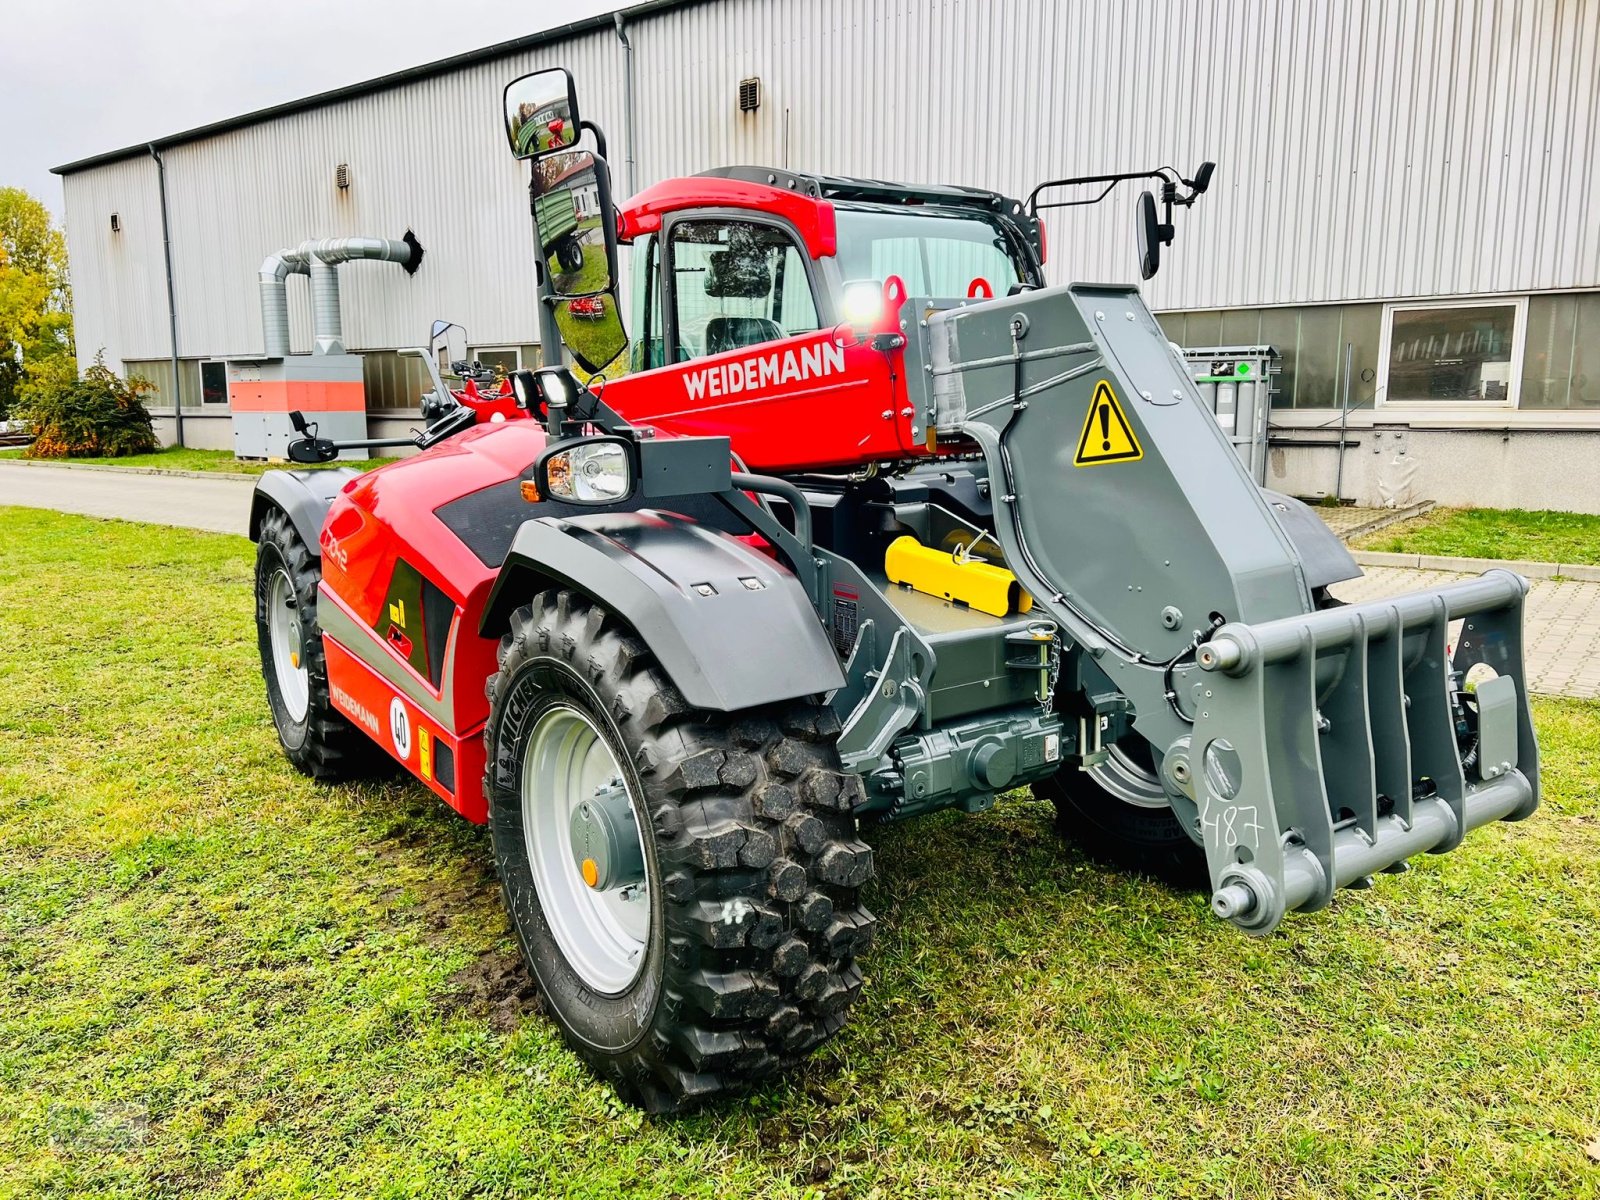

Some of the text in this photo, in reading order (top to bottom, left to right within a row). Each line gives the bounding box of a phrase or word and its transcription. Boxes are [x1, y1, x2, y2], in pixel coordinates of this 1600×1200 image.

[682, 338, 845, 401] WEIDEMANN
[330, 682, 380, 736] WEIDEMANN
[394, 707, 407, 749] 40
[1202, 797, 1265, 848] 487
